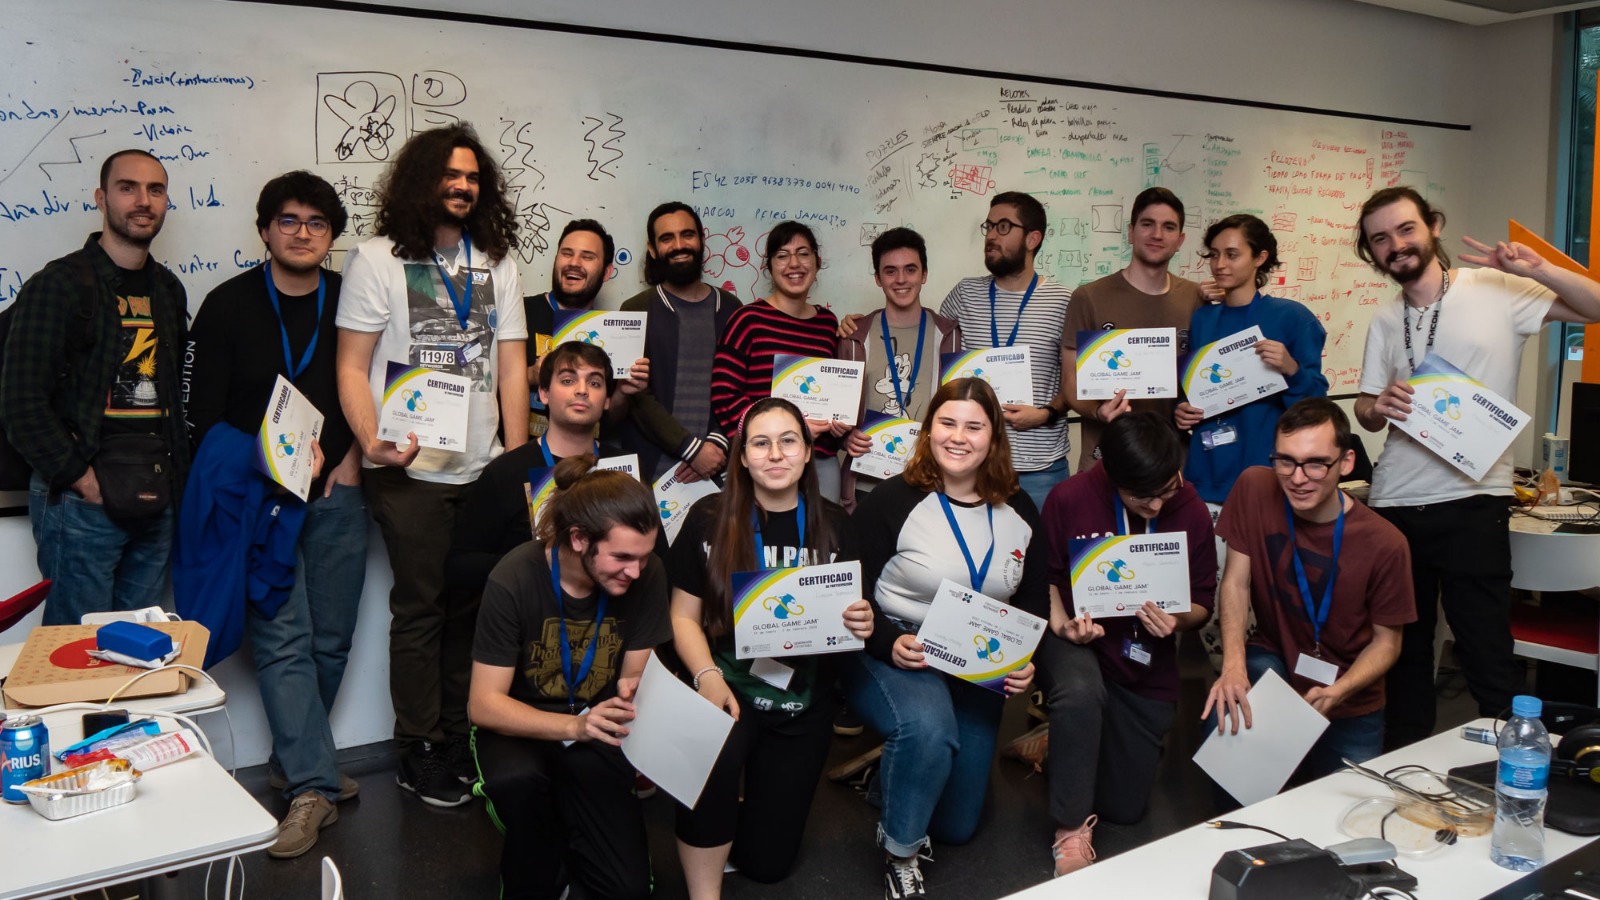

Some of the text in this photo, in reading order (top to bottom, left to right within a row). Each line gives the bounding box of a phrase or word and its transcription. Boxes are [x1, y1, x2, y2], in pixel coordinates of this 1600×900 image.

[603, 319, 642, 327] CERTIFICADO
[1127, 336, 1170, 345] CERTIFICADO
[1218, 335, 1258, 356] CERTIFICADO
[421, 350, 454, 364] 119/8
[985, 353, 1025, 363] CERTIFICADO
[181, 340, 197, 403] EDITION
[820, 365, 859, 376] CERTIFICADO
[427, 379, 465, 393] CERTIFICADO
[272, 385, 289, 424] CERTIFICADO
[1471, 392, 1519, 428] CERTIFICADO
[1129, 541, 1180, 553] CERTIFICADO
[799, 572, 853, 587] CERTIFICADO
[752, 622, 779, 631] GLOBAL
[781, 620, 801, 628] GAME
[983, 625, 1003, 637] GAME
[1001, 633, 1022, 646] GLOBAL
